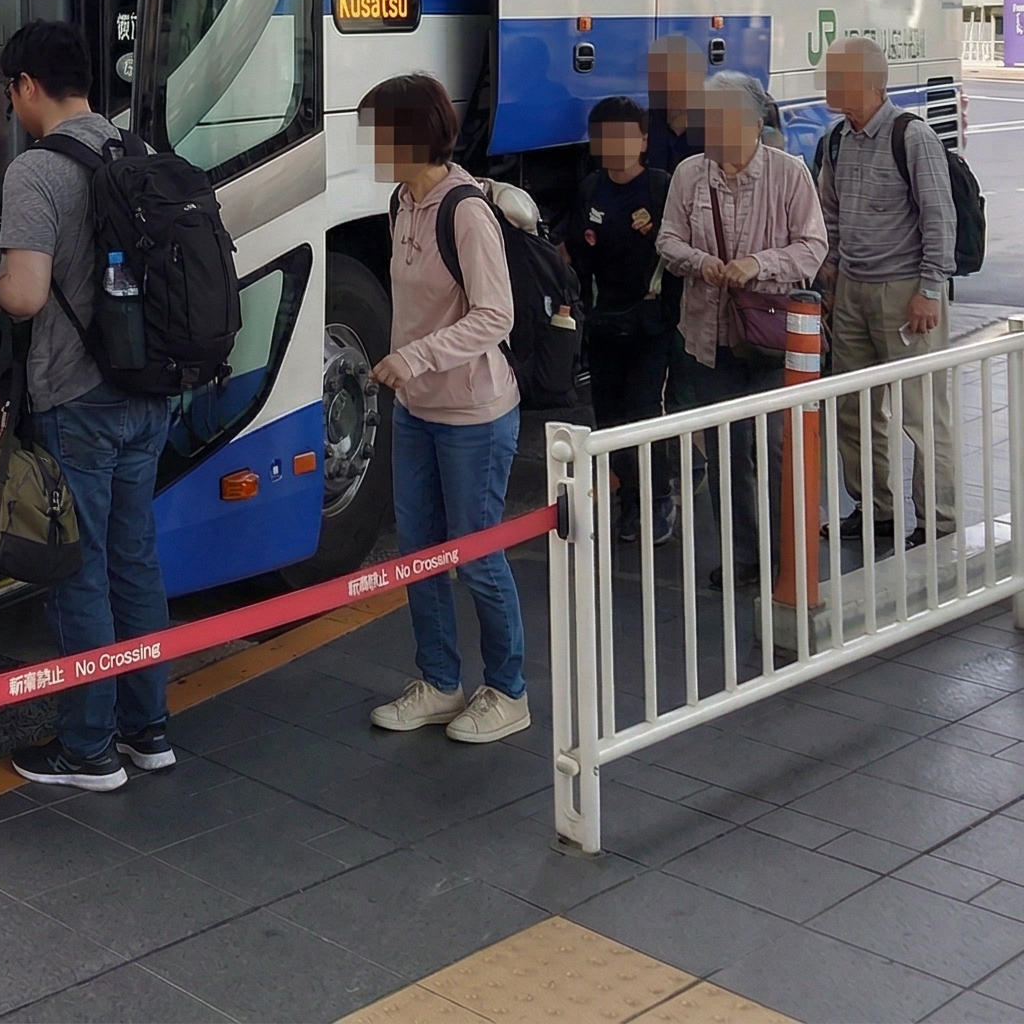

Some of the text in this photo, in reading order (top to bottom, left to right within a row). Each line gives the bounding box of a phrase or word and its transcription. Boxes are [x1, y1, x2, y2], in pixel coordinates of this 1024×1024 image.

[396, 564, 410, 580] No
[75, 659, 95, 677] No
[99, 642, 161, 671] Crossing
